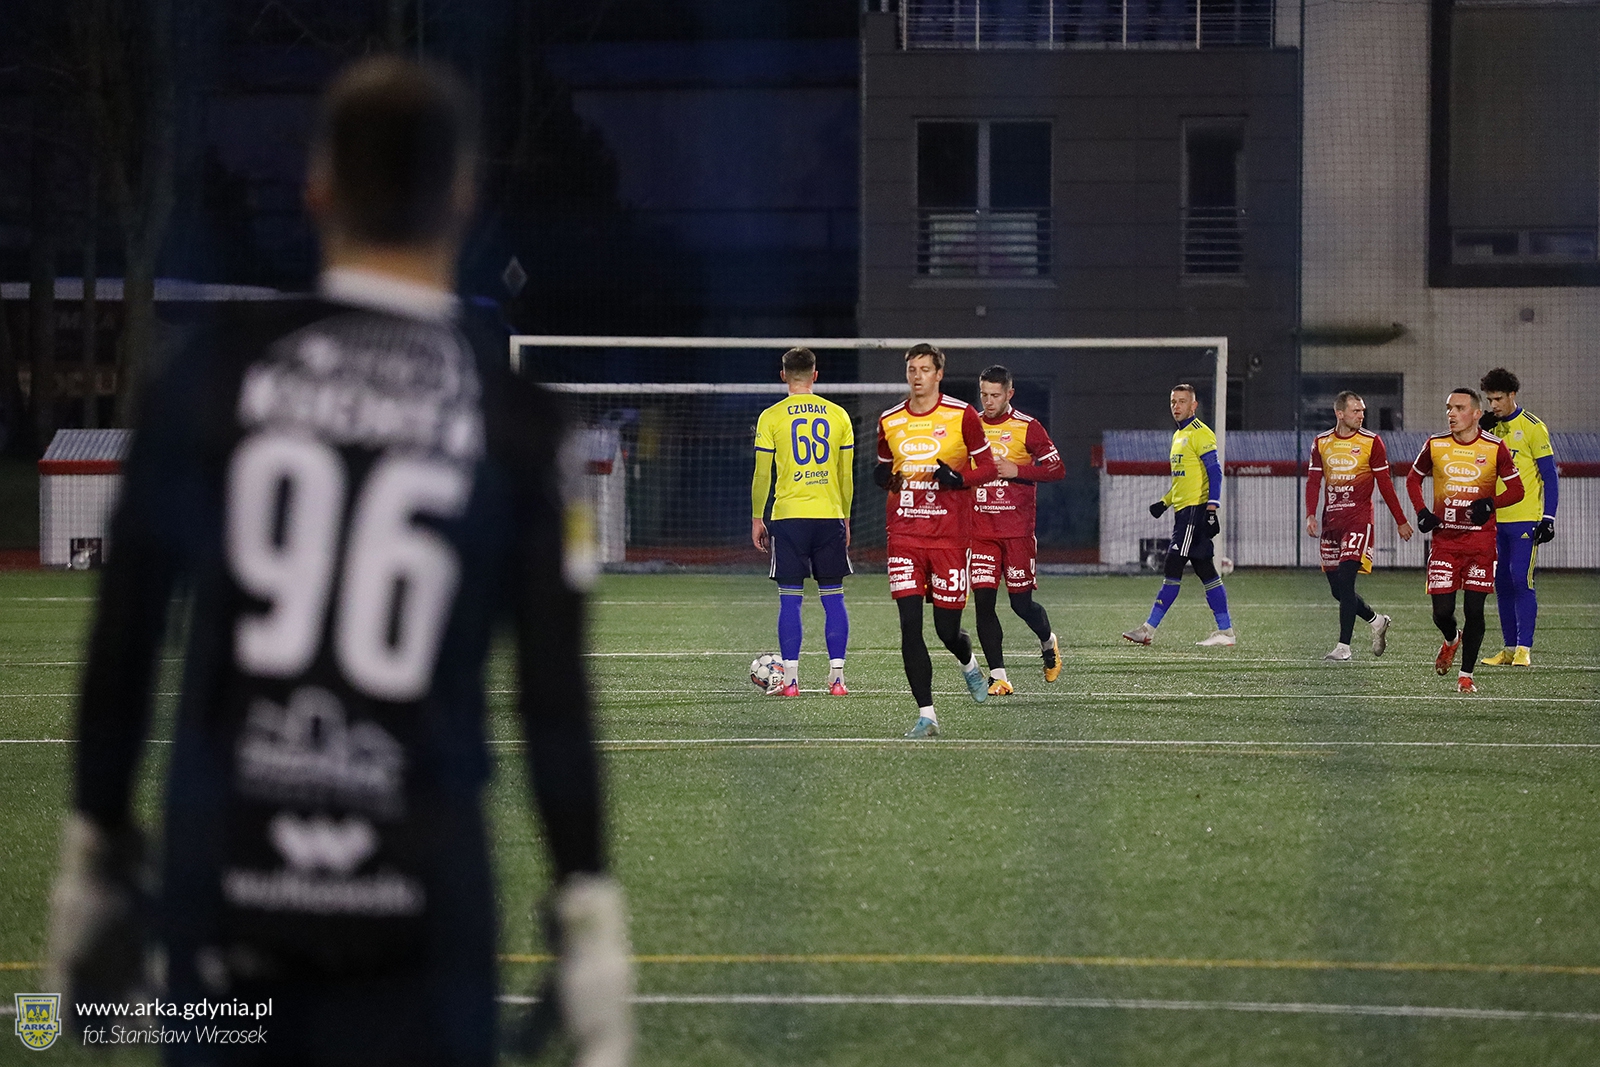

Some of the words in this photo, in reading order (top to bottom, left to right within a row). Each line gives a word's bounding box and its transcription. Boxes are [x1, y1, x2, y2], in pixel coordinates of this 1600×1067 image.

[788, 404, 827, 415] CZUBAK
[791, 418, 830, 466] 68
[903, 442, 935, 452] Skiba
[1329, 458, 1354, 466] Skiba
[1448, 465, 1476, 477] Skiba
[909, 481, 939, 490] EMKA
[1445, 484, 1480, 494] GINTER
[1452, 499, 1473, 507] EMK
[1348, 532, 1364, 549] 27
[888, 556, 914, 565] STAPOL
[971, 553, 996, 562] STAPOL
[226, 432, 474, 700] 96
[1430, 560, 1454, 569] STAPOL
